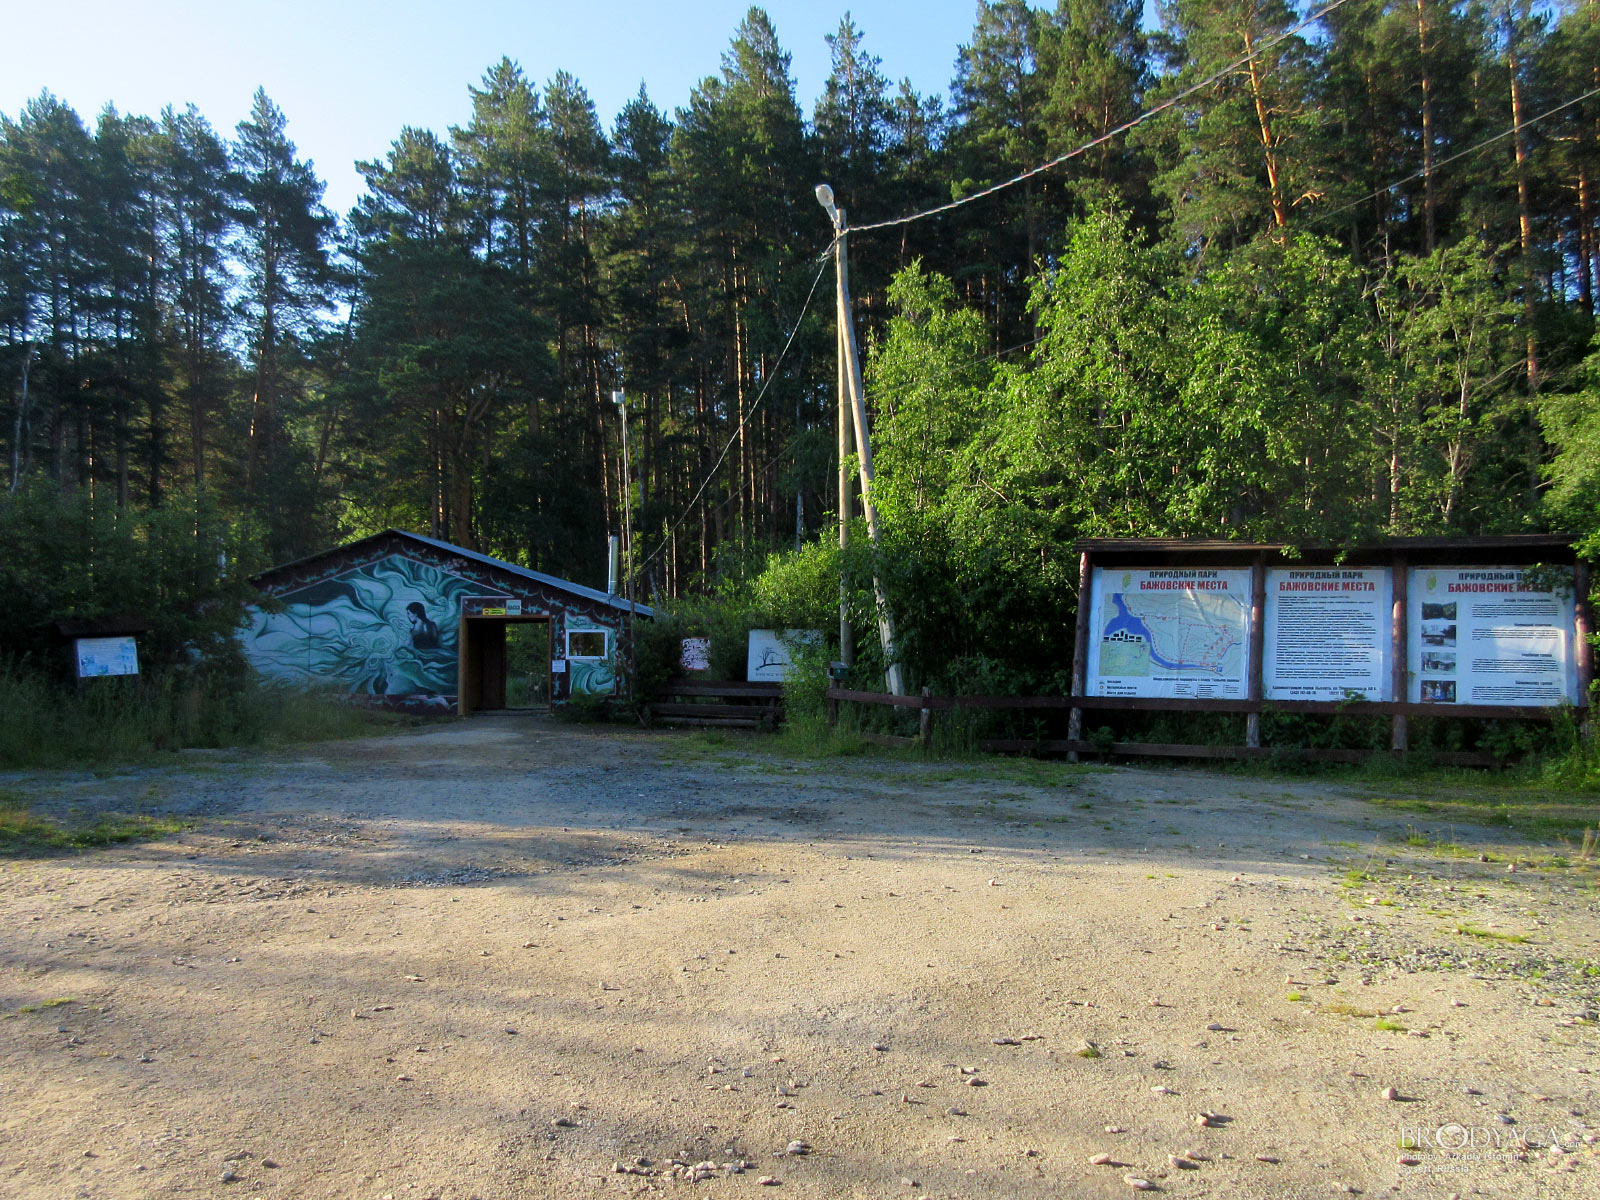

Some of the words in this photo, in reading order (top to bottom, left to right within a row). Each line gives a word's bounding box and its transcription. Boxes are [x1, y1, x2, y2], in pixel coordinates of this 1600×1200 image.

[1149, 570, 1197, 579] ПРИРОДНЫЙ
[1197, 570, 1218, 578] ПАРК
[1289, 571, 1340, 580] ПРИРОДНЫЙ
[1342, 571, 1363, 579] ПАРК
[1458, 572, 1514, 581] ПРИРОДНЫЙ
[1140, 580, 1196, 590] БАЖОВСКИЕ
[1197, 580, 1228, 590] МЕСТА
[1279, 581, 1340, 591] БАЖОВСКИЕ
[1341, 581, 1375, 591] МЕСТА
[1448, 583, 1514, 593] БАЖОВСКИЕ
